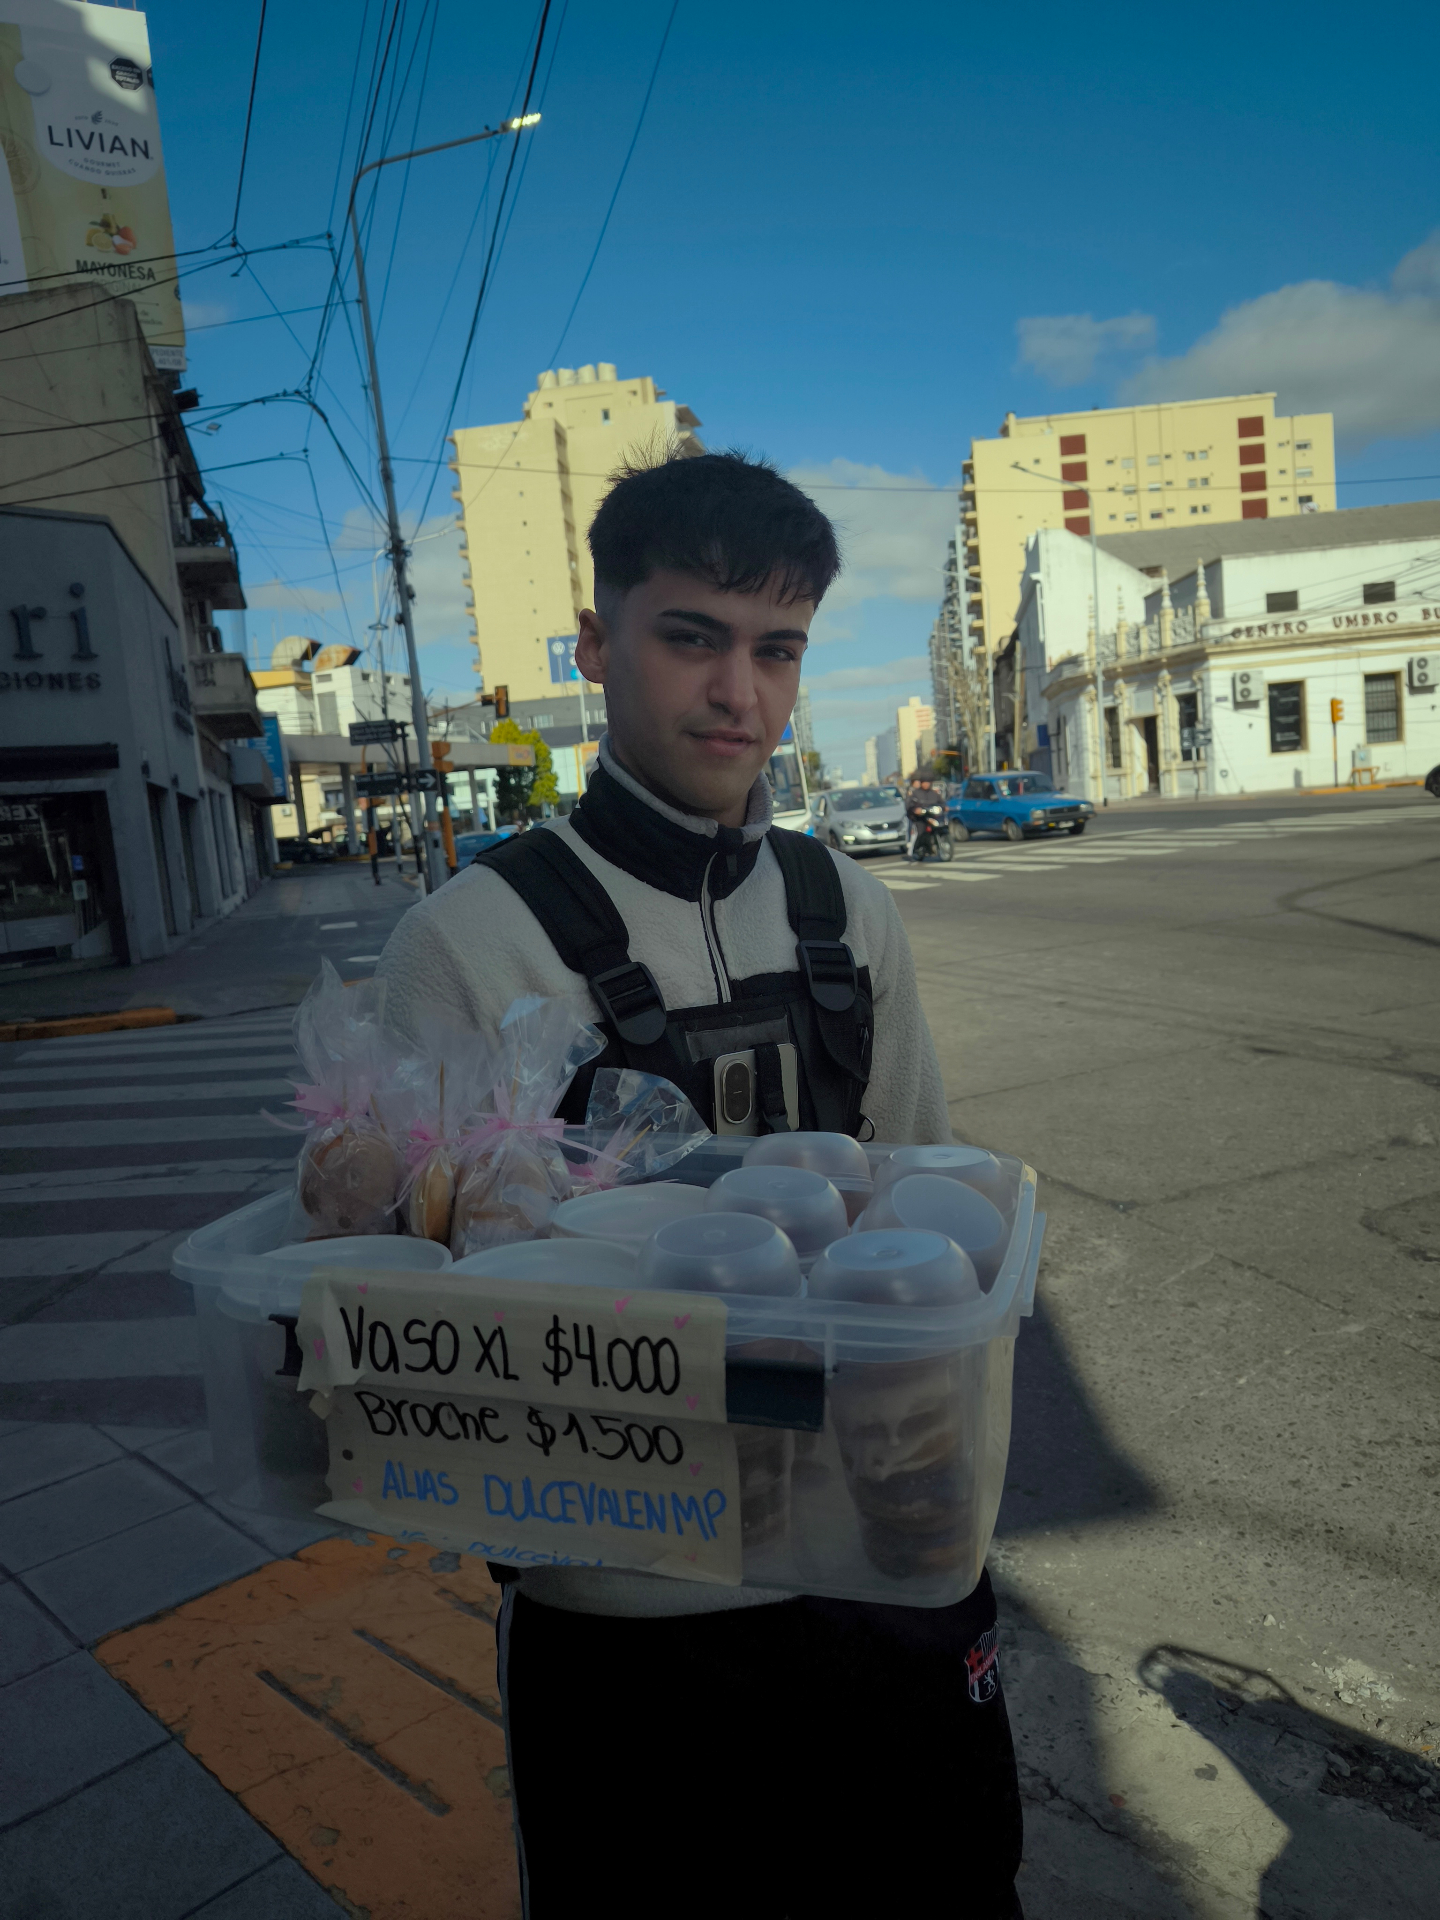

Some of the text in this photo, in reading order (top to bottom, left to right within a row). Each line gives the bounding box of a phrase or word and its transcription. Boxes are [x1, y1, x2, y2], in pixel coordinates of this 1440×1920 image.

[47, 125, 150, 160] LIVIAN
[76, 259, 156, 282] MAYONESA
[1231, 620, 1309, 639] CENTRO
[1332, 611, 1399, 629] UMBRO
[473, 1325, 519, 1381] XL
[542, 1314, 682, 1396] $4.000
[354, 1390, 684, 1465] Broche $1.500
[381, 1460, 458, 1506] ALIAS
